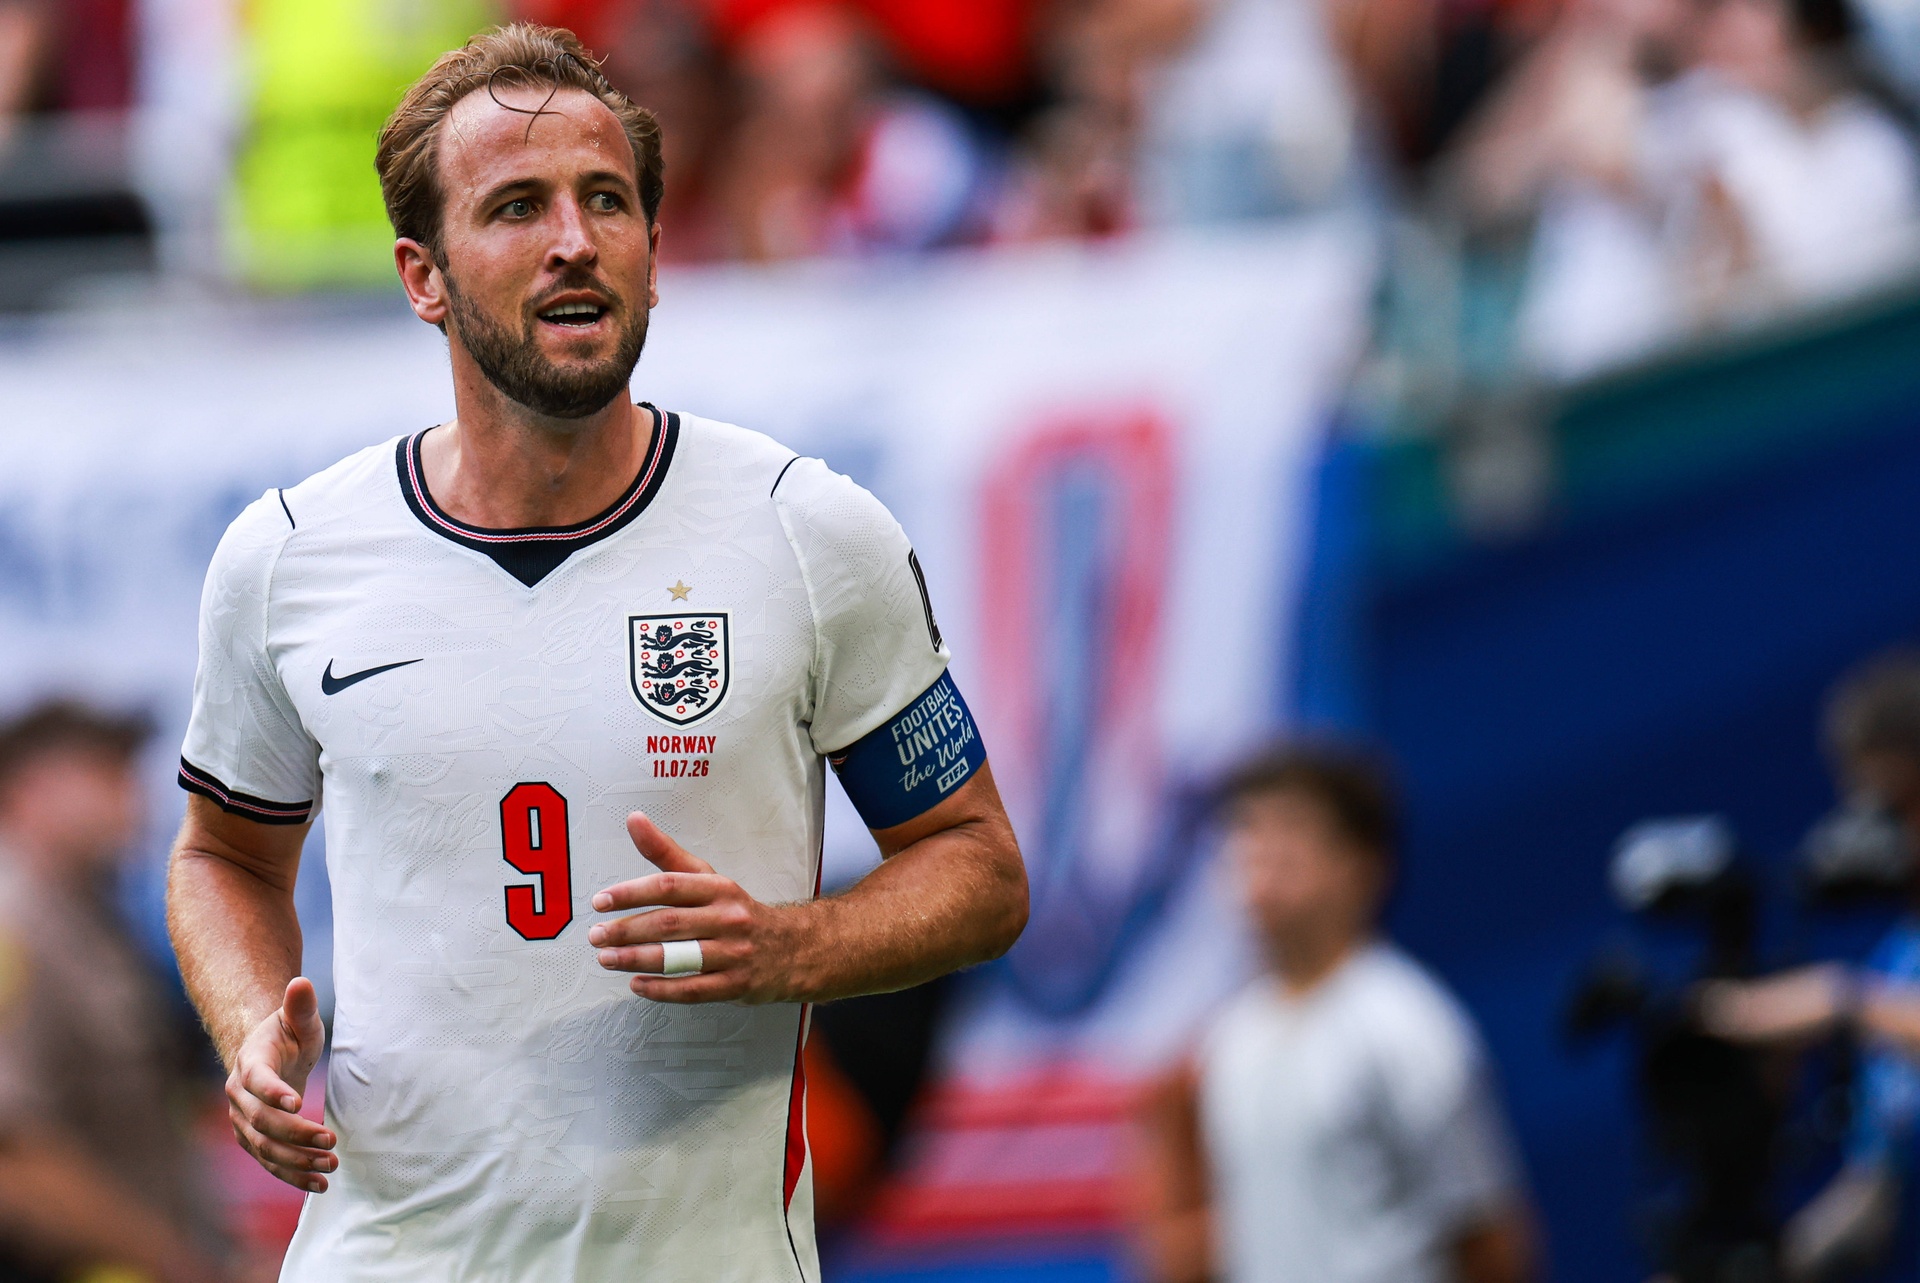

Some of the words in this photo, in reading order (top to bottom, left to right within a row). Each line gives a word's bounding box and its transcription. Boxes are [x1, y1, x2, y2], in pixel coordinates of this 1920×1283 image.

[891, 679, 952, 743] FOOTBALL
[897, 695, 963, 766] UNITES
[647, 736, 717, 754] NORWAY
[653, 760, 710, 778] 11.07.26
[898, 764, 935, 792] the
[936, 716, 974, 768] World
[939, 760, 968, 789] FIFA
[499, 781, 573, 940] 9
